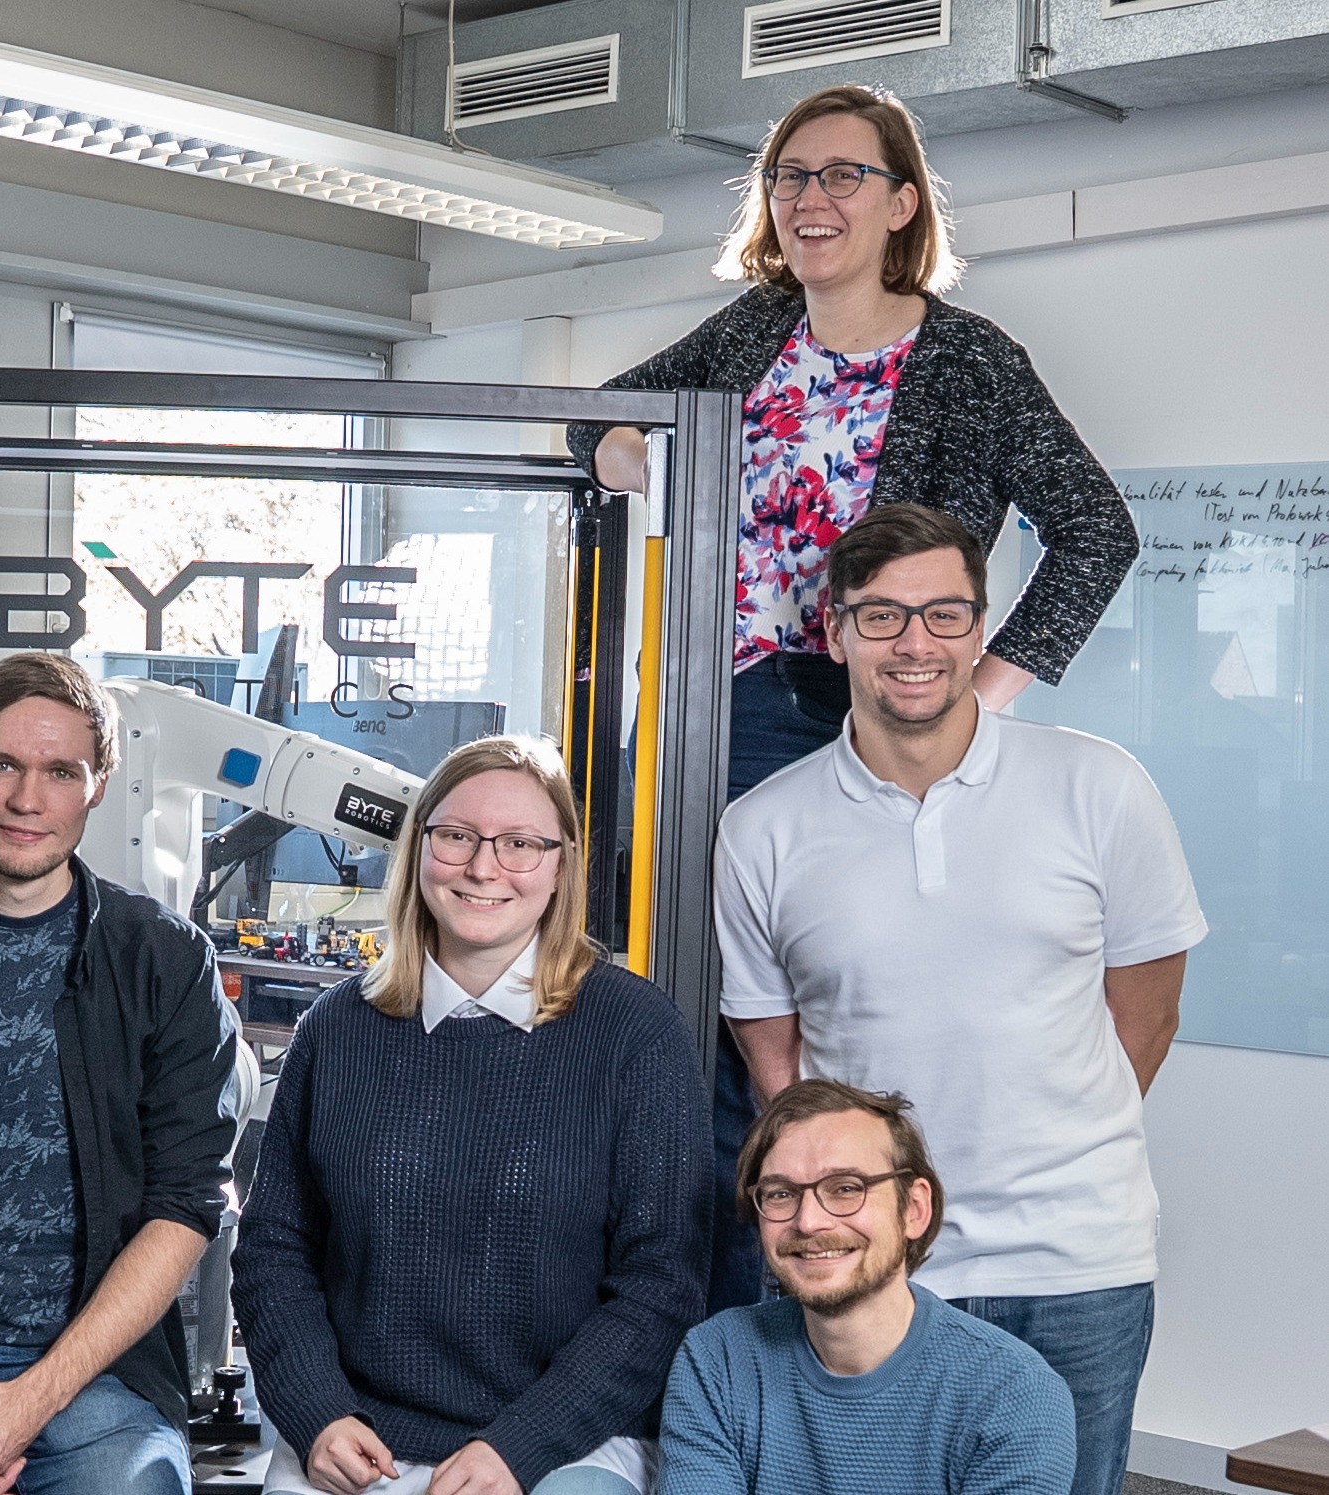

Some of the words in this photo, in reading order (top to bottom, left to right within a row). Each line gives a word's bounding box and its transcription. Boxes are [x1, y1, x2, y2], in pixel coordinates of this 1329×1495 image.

[351, 719, 387, 736] BenQ
[344, 808, 390, 830] ROBOTICS
[346, 795, 395, 823] BYTE
